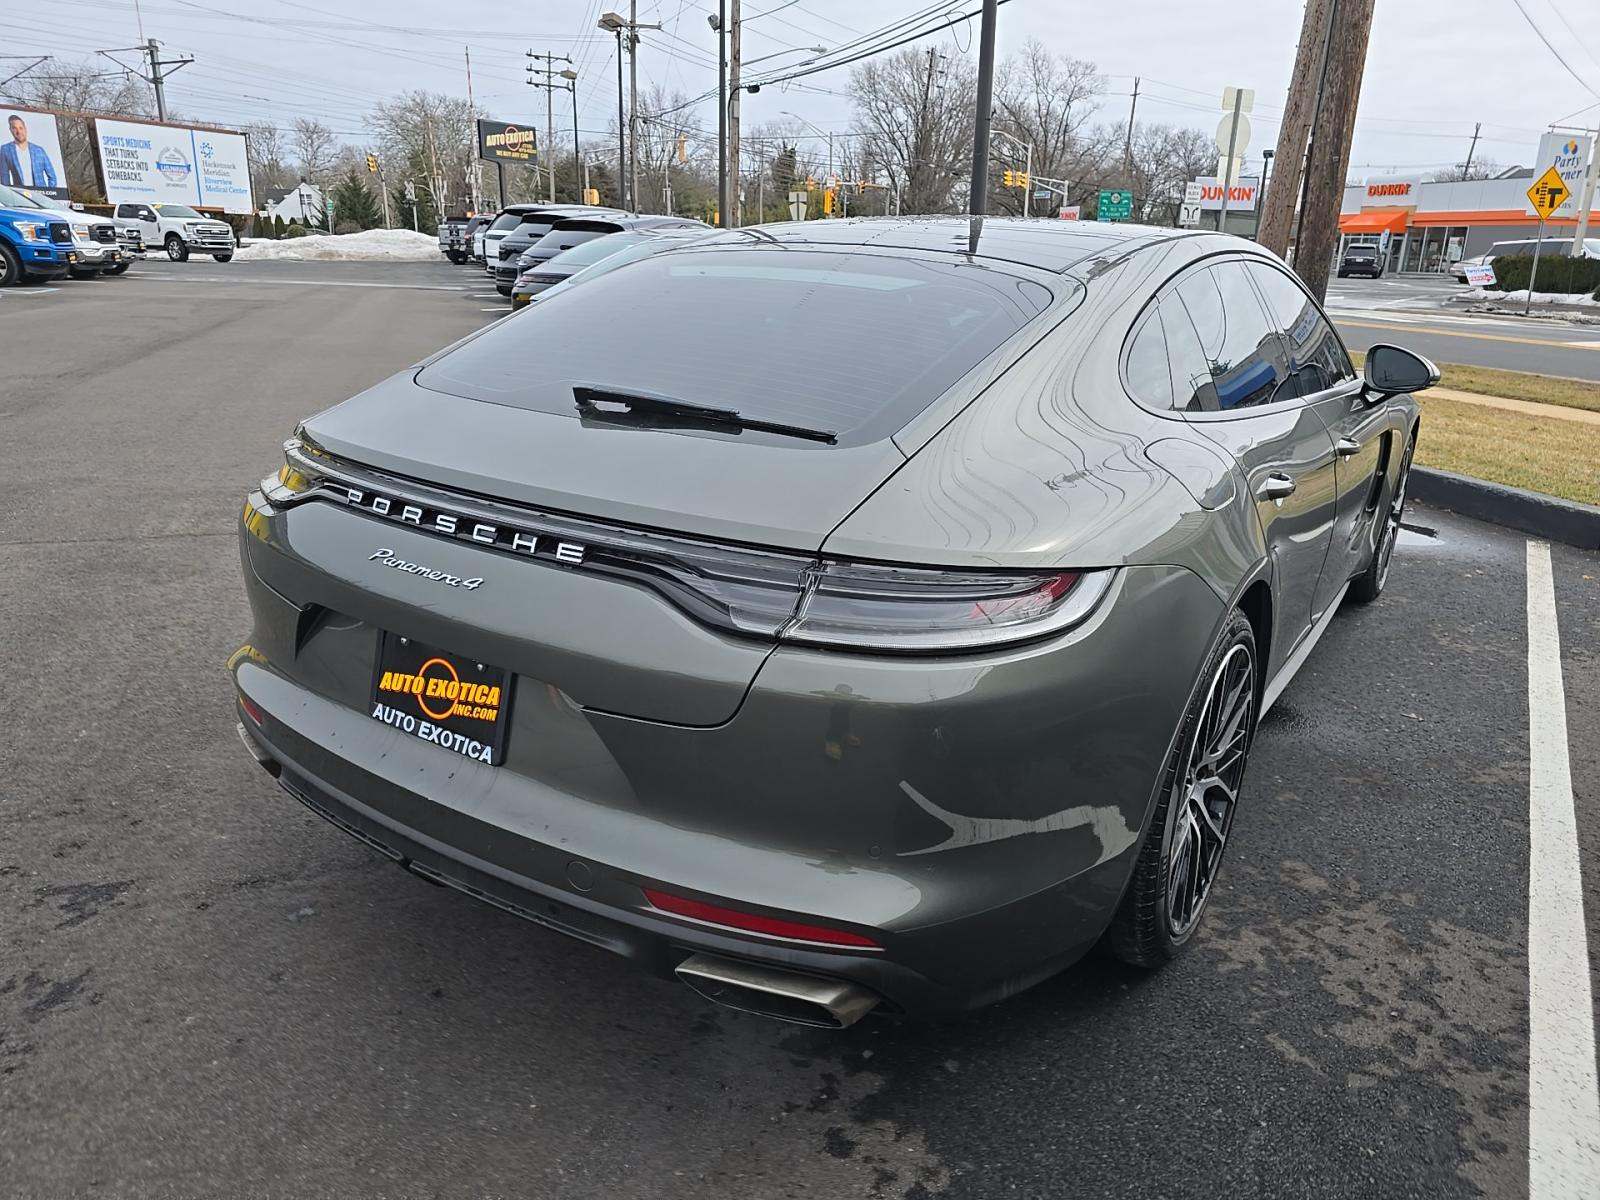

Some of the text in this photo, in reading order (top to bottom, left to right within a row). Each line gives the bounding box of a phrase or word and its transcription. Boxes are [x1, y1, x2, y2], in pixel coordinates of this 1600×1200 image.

[102, 136, 152, 150] SPORTS MEDICINE
[486, 131, 534, 147] AUTO EXOTICA
[104, 147, 139, 160] THAT TURNS
[106, 159, 149, 171] SETBACKS INTO
[1553, 155, 1582, 168] Party
[107, 170, 144, 182] COMEBACKS.
[1560, 169, 1583, 180] rner
[1200, 186, 1255, 201] DUNKIN'
[1368, 183, 1412, 197] DUNKIN'
[347, 488, 585, 564] PORSCHE
[368, 548, 485, 591] Panamera 4
[379, 671, 501, 707] AUTO EXOTICA
[452, 703, 498, 722] INC.COM
[372, 703, 495, 765] AUTO EXOTICA
